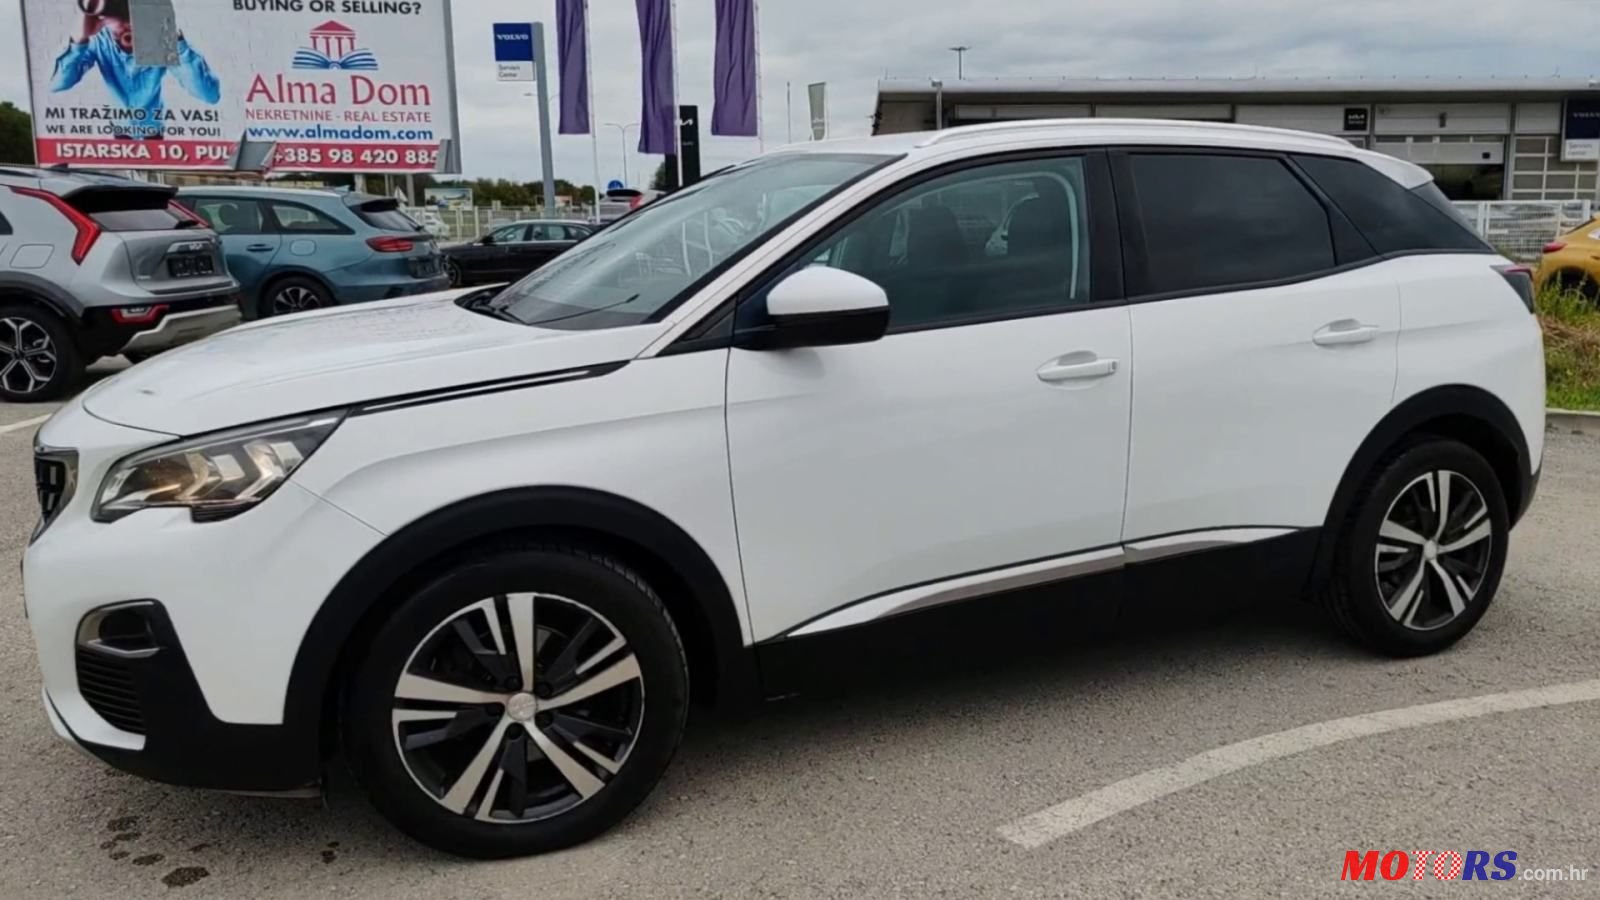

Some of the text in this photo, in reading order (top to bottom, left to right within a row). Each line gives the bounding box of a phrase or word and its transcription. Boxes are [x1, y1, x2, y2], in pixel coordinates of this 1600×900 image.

[232, 0, 422, 15] BUYING OR SELLING?
[246, 73, 431, 106] Alma Dom
[45, 105, 219, 122] MI TRAŽIMO ZA VAS!
[245, 109, 333, 121] NEKRETNINE
[344, 111, 379, 122] REAL
[382, 112, 432, 123] ESTATE
[46, 125, 221, 137] WE ARE LOOKING FOR YOU!
[249, 124, 433, 140] www.almadom.com
[56, 143, 151, 158] ISTARSKA
[158, 145, 189, 161] 10,
[273, 148, 321, 163] +385
[328, 150, 354, 164] 98
[360, 150, 399, 164] 420
